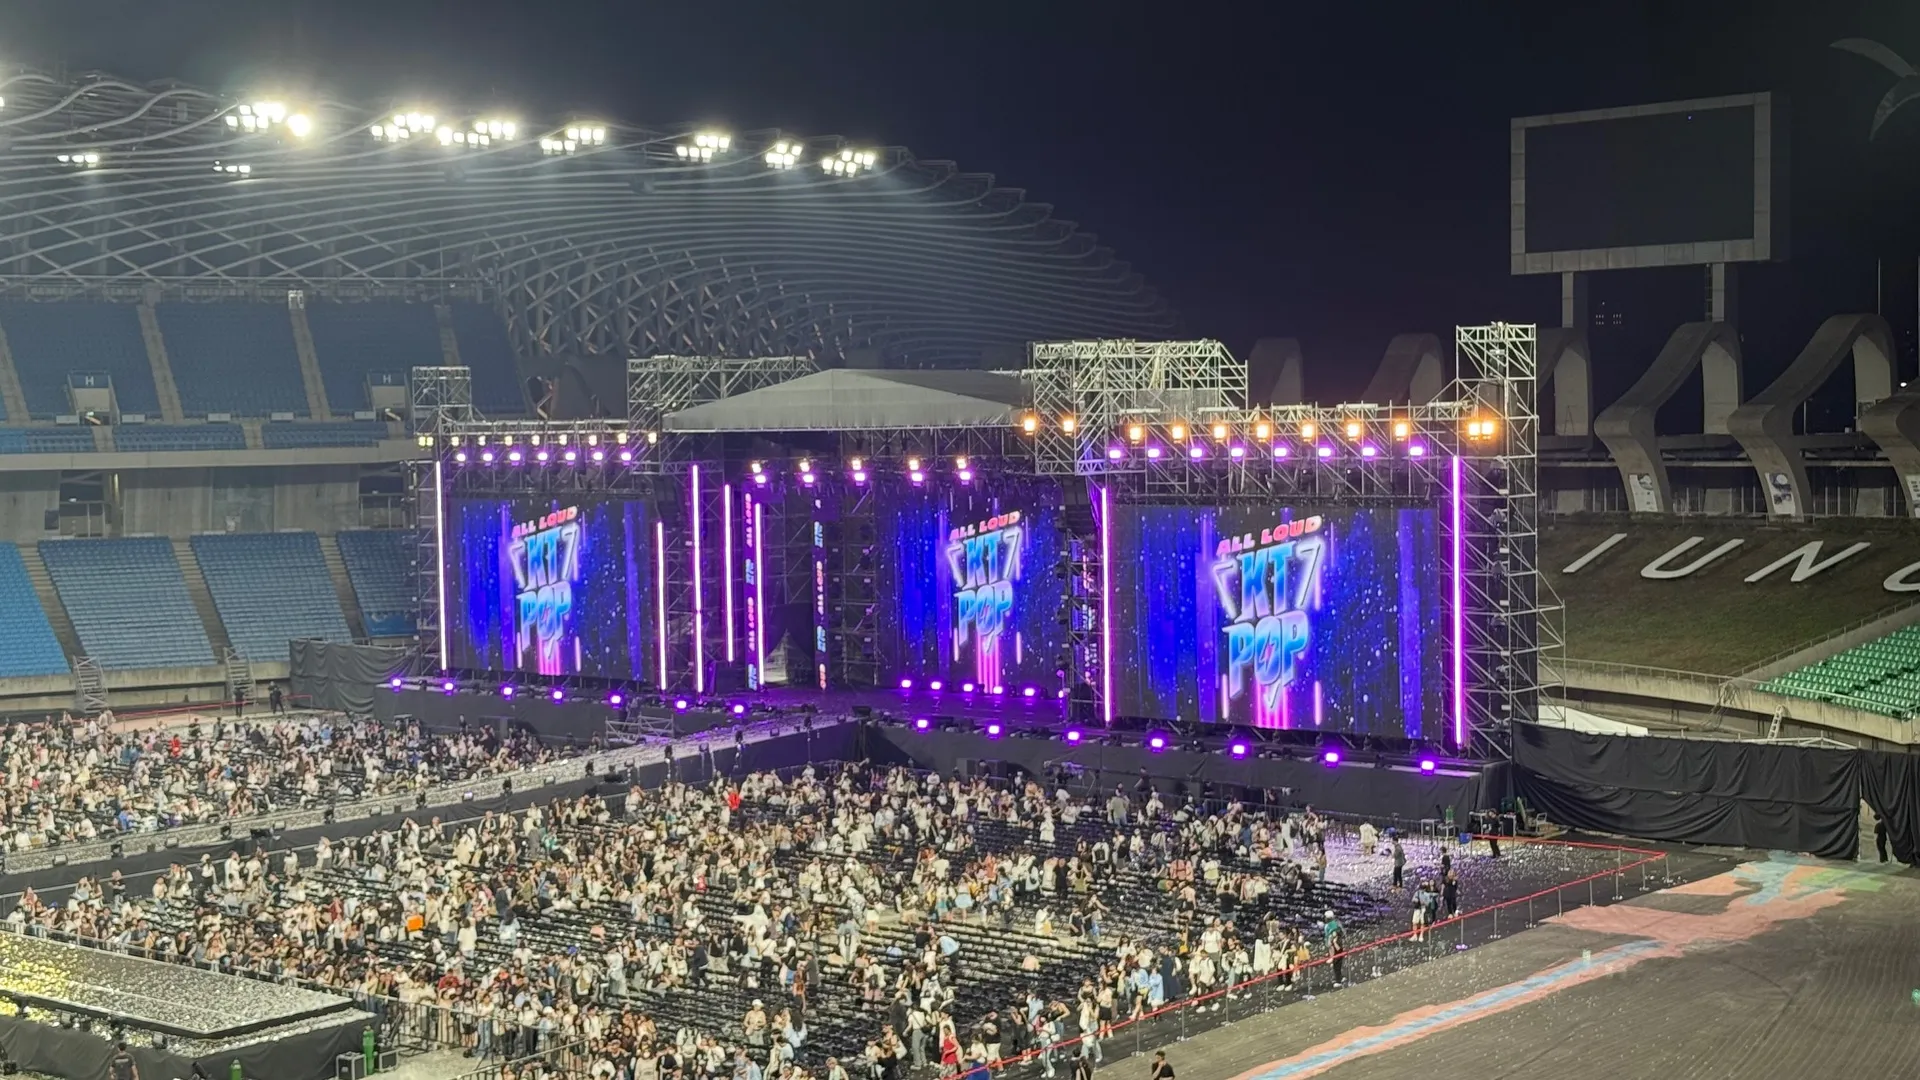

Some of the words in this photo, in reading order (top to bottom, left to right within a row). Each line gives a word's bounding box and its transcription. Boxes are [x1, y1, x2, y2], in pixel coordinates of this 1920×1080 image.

[85, 375, 95, 386] H
[383, 374, 392, 384] H
[512, 520, 536, 538] ALL
[539, 506, 578, 530] LOUD
[949, 524, 976, 540] ALL
[979, 511, 1021, 533] LOUD
[1216, 532, 1255, 556] ALL
[1260, 515, 1322, 545] LOUD
[516, 580, 572, 652] POP
[954, 580, 1013, 646] POP
[1222, 610, 1309, 700] POP
